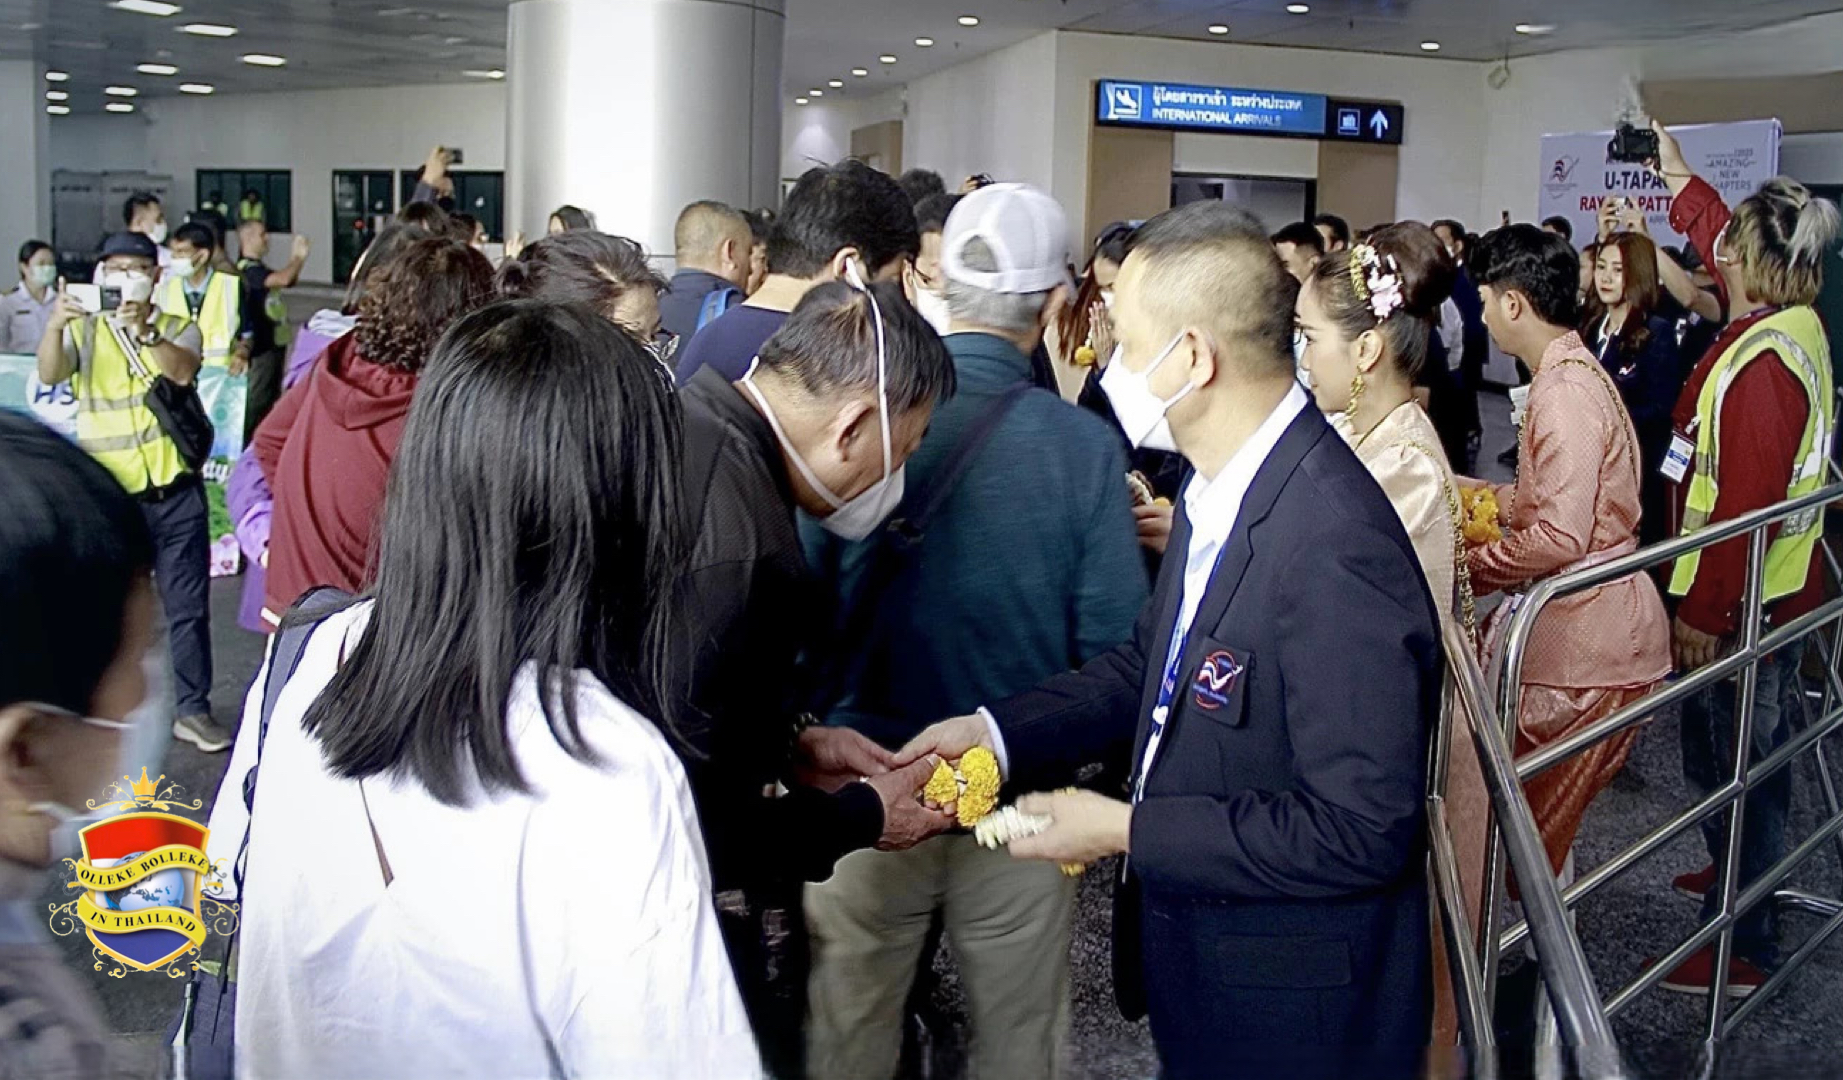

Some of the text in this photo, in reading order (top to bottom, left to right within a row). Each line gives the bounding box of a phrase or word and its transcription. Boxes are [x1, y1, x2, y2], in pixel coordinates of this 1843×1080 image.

[1152, 107, 1282, 126] INTERNATIONAL ARRIVALS
[1605, 171, 1669, 190] U-TAPA
[1580, 195, 1673, 211] RAY PATT
